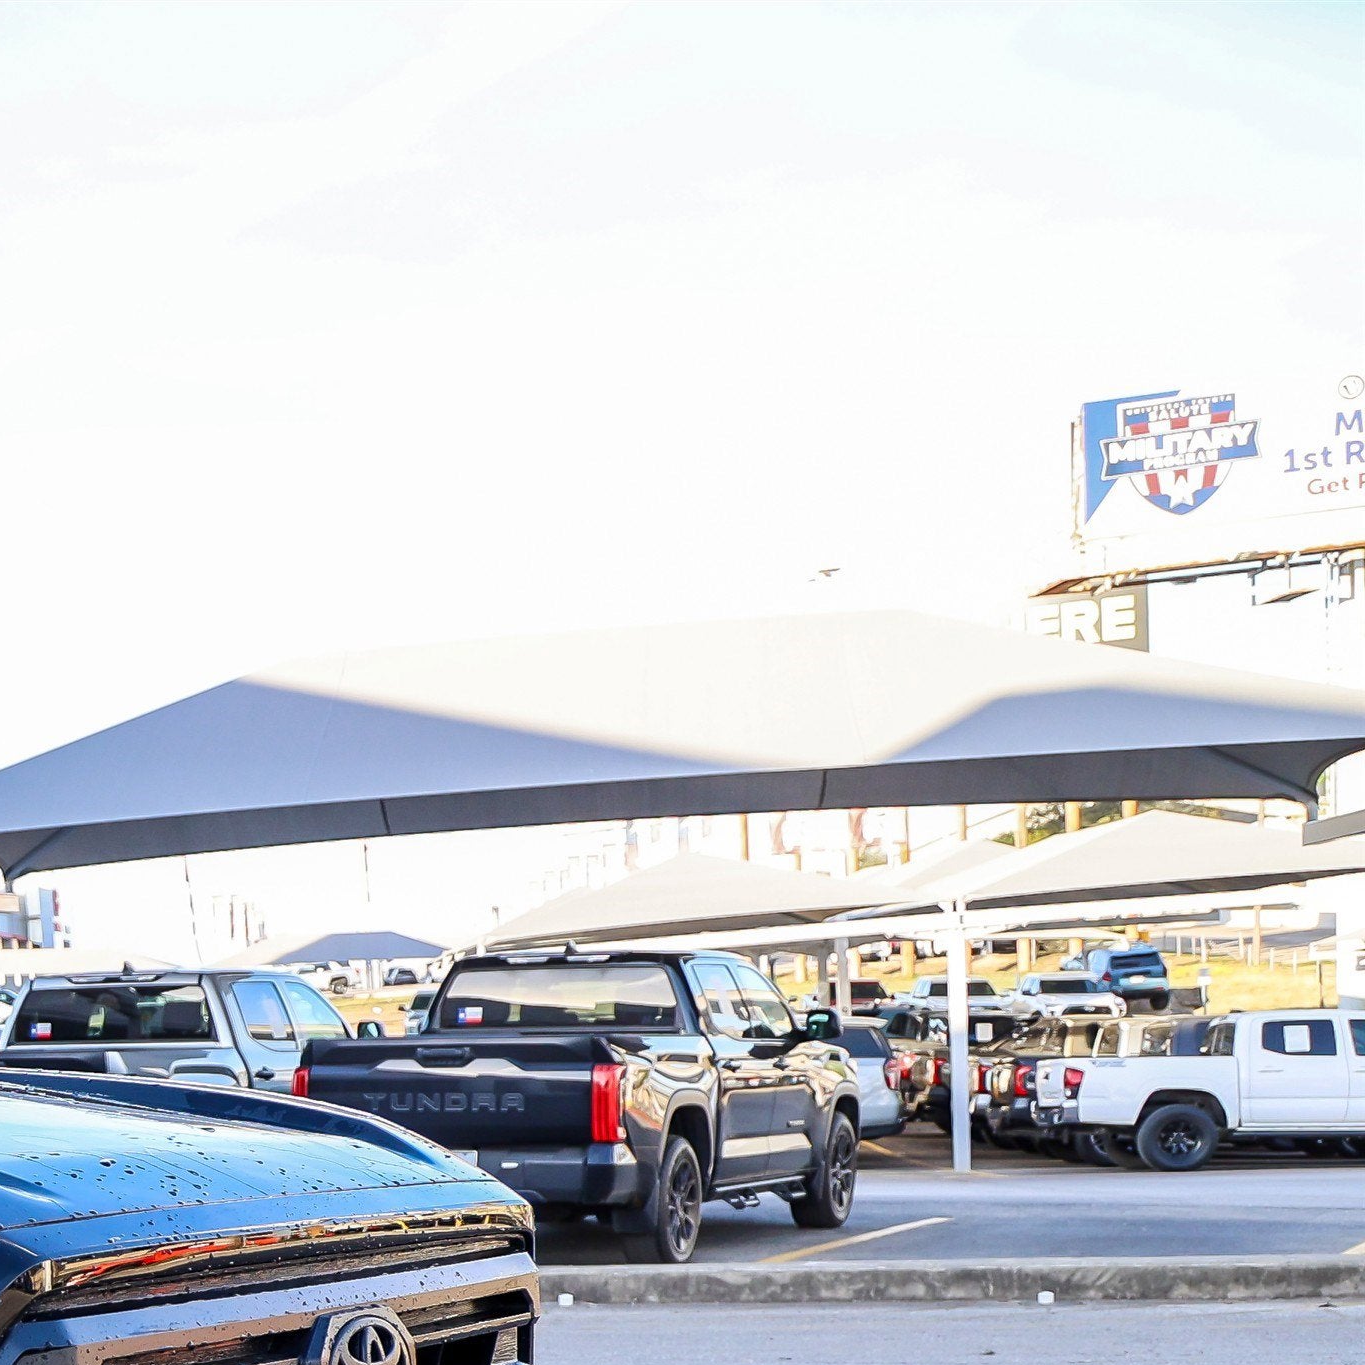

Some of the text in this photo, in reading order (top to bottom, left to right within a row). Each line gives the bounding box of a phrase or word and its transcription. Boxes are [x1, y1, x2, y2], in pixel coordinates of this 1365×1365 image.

[1108, 422, 1255, 464] MILITARY
[1284, 446, 1333, 473] 1st
[1307, 476, 1350, 495] Get
[362, 1092, 525, 1112] TUNDRA
